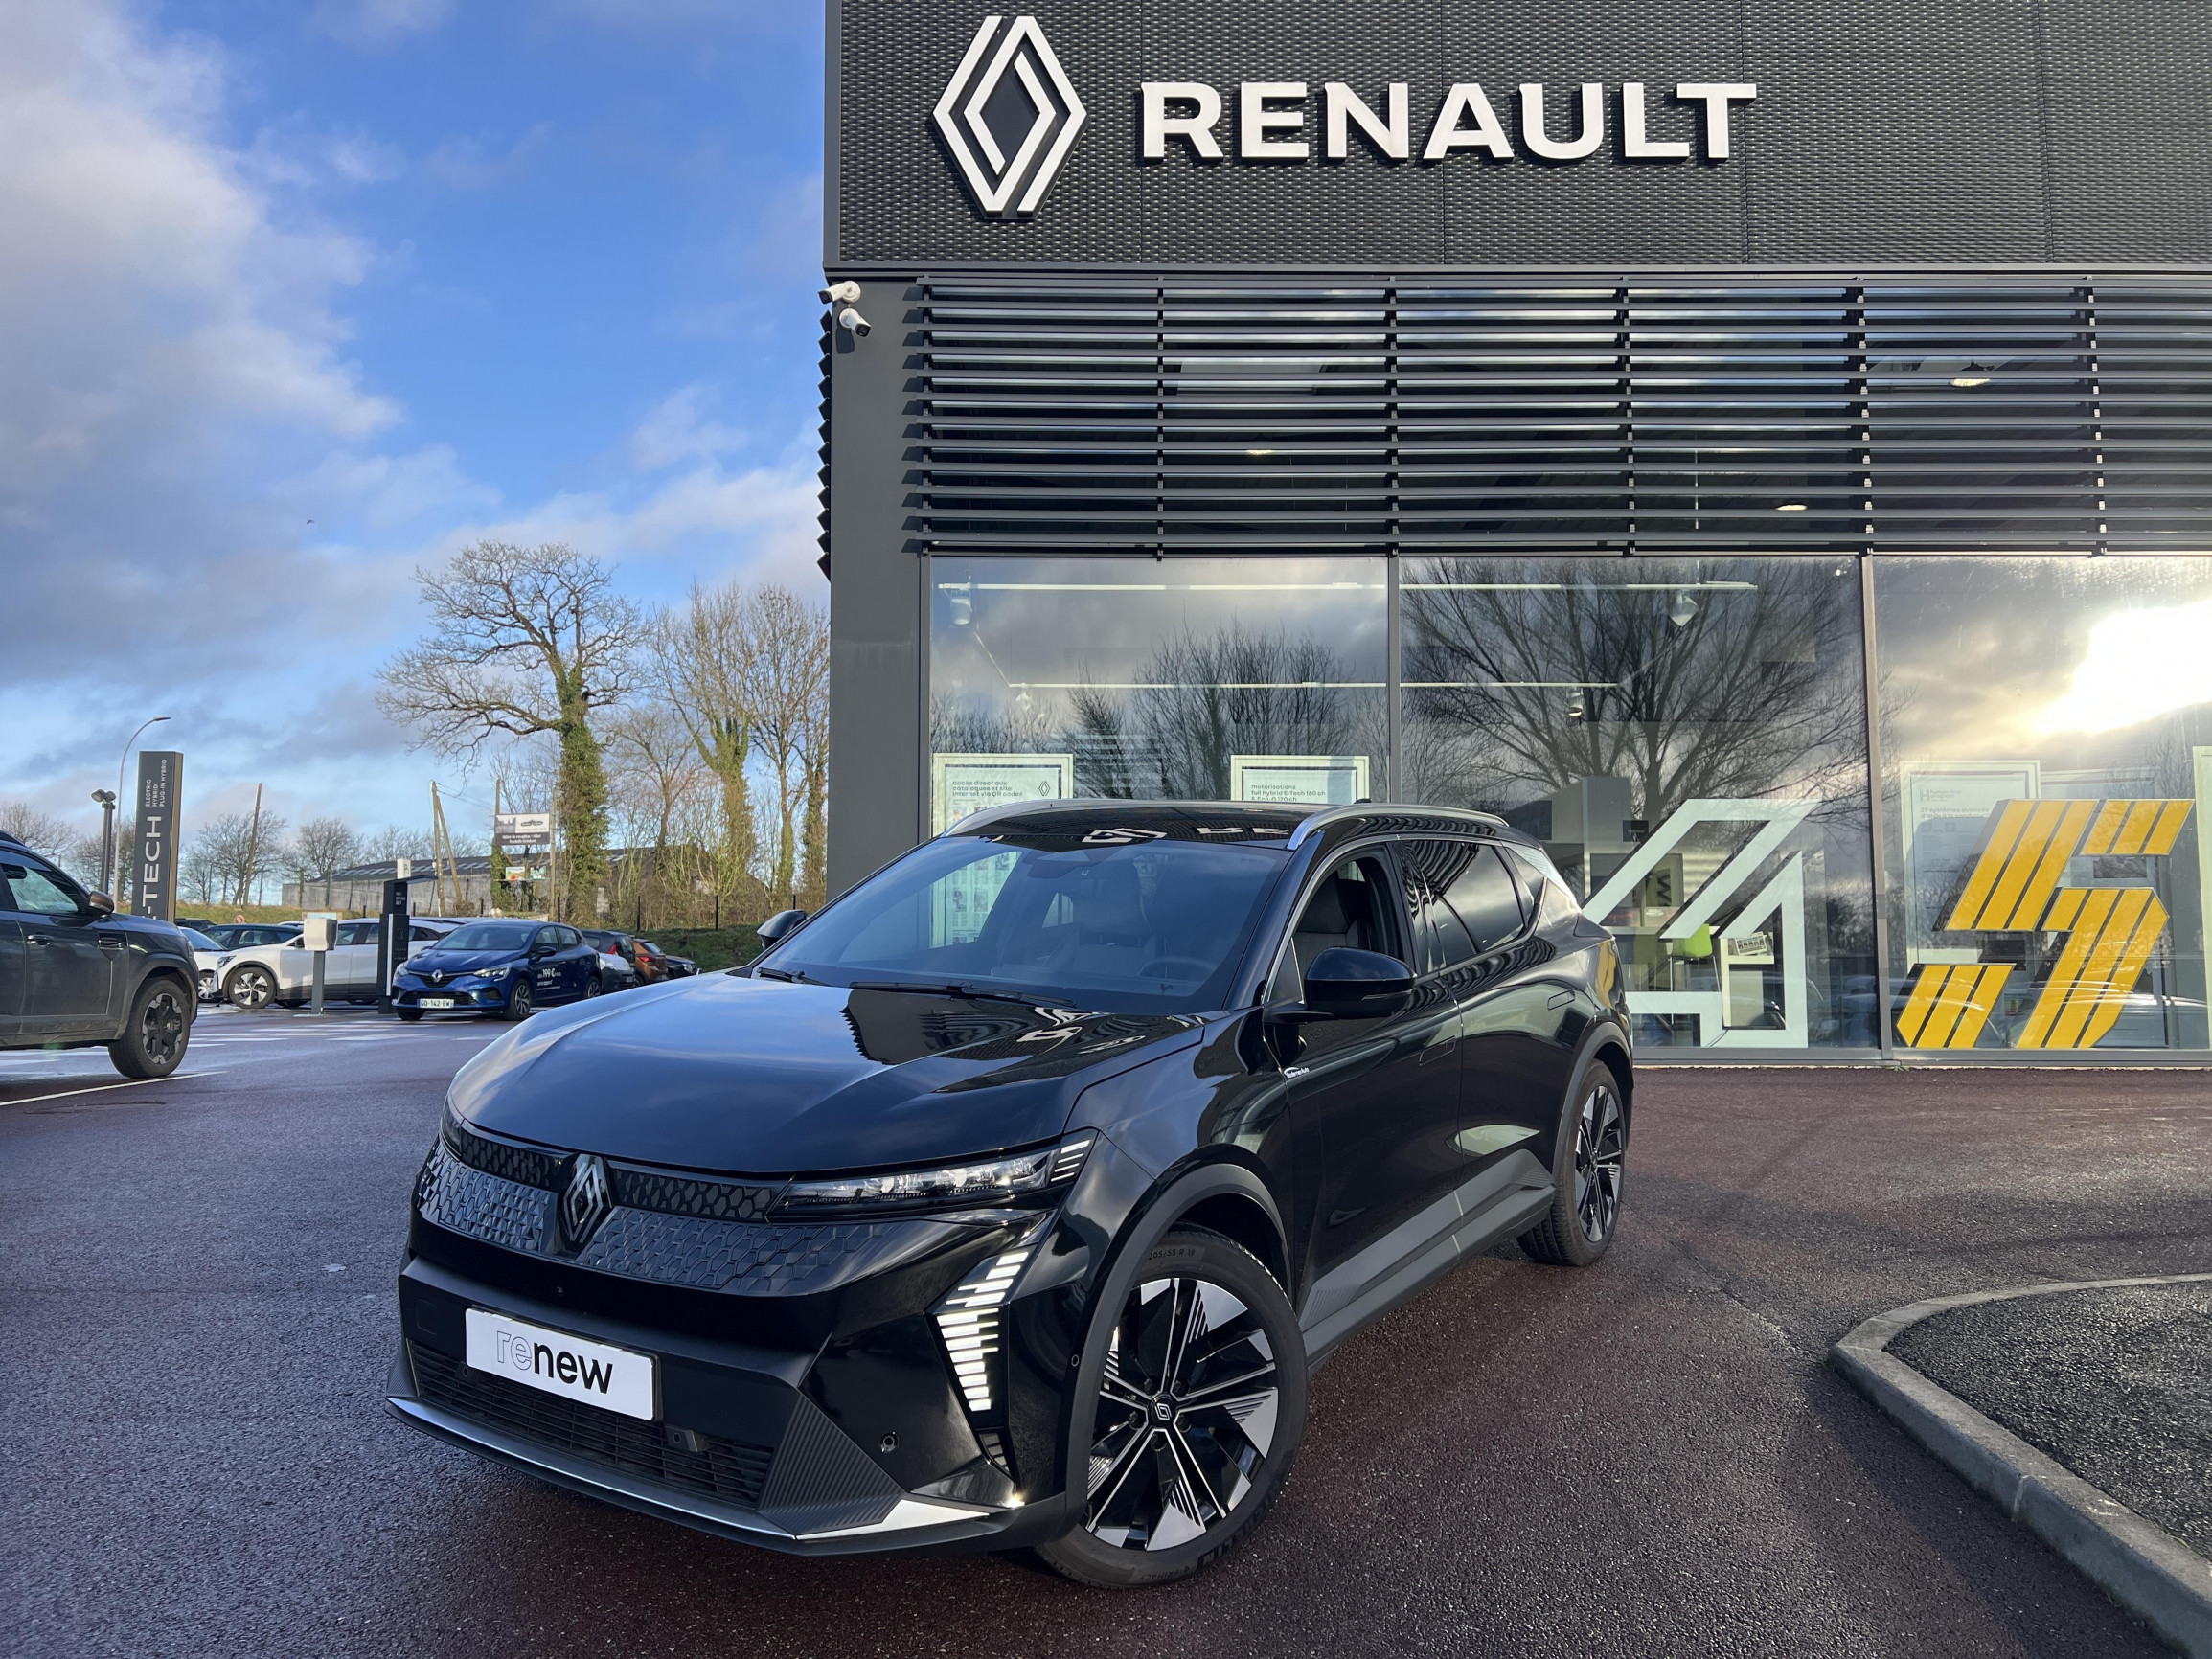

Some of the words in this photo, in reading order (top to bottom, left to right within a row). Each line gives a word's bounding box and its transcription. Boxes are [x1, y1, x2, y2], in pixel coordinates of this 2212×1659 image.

[1141, 81, 1757, 160] RENAULT
[142, 815, 162, 920] -TECH
[494, 1330, 614, 1394] renew
